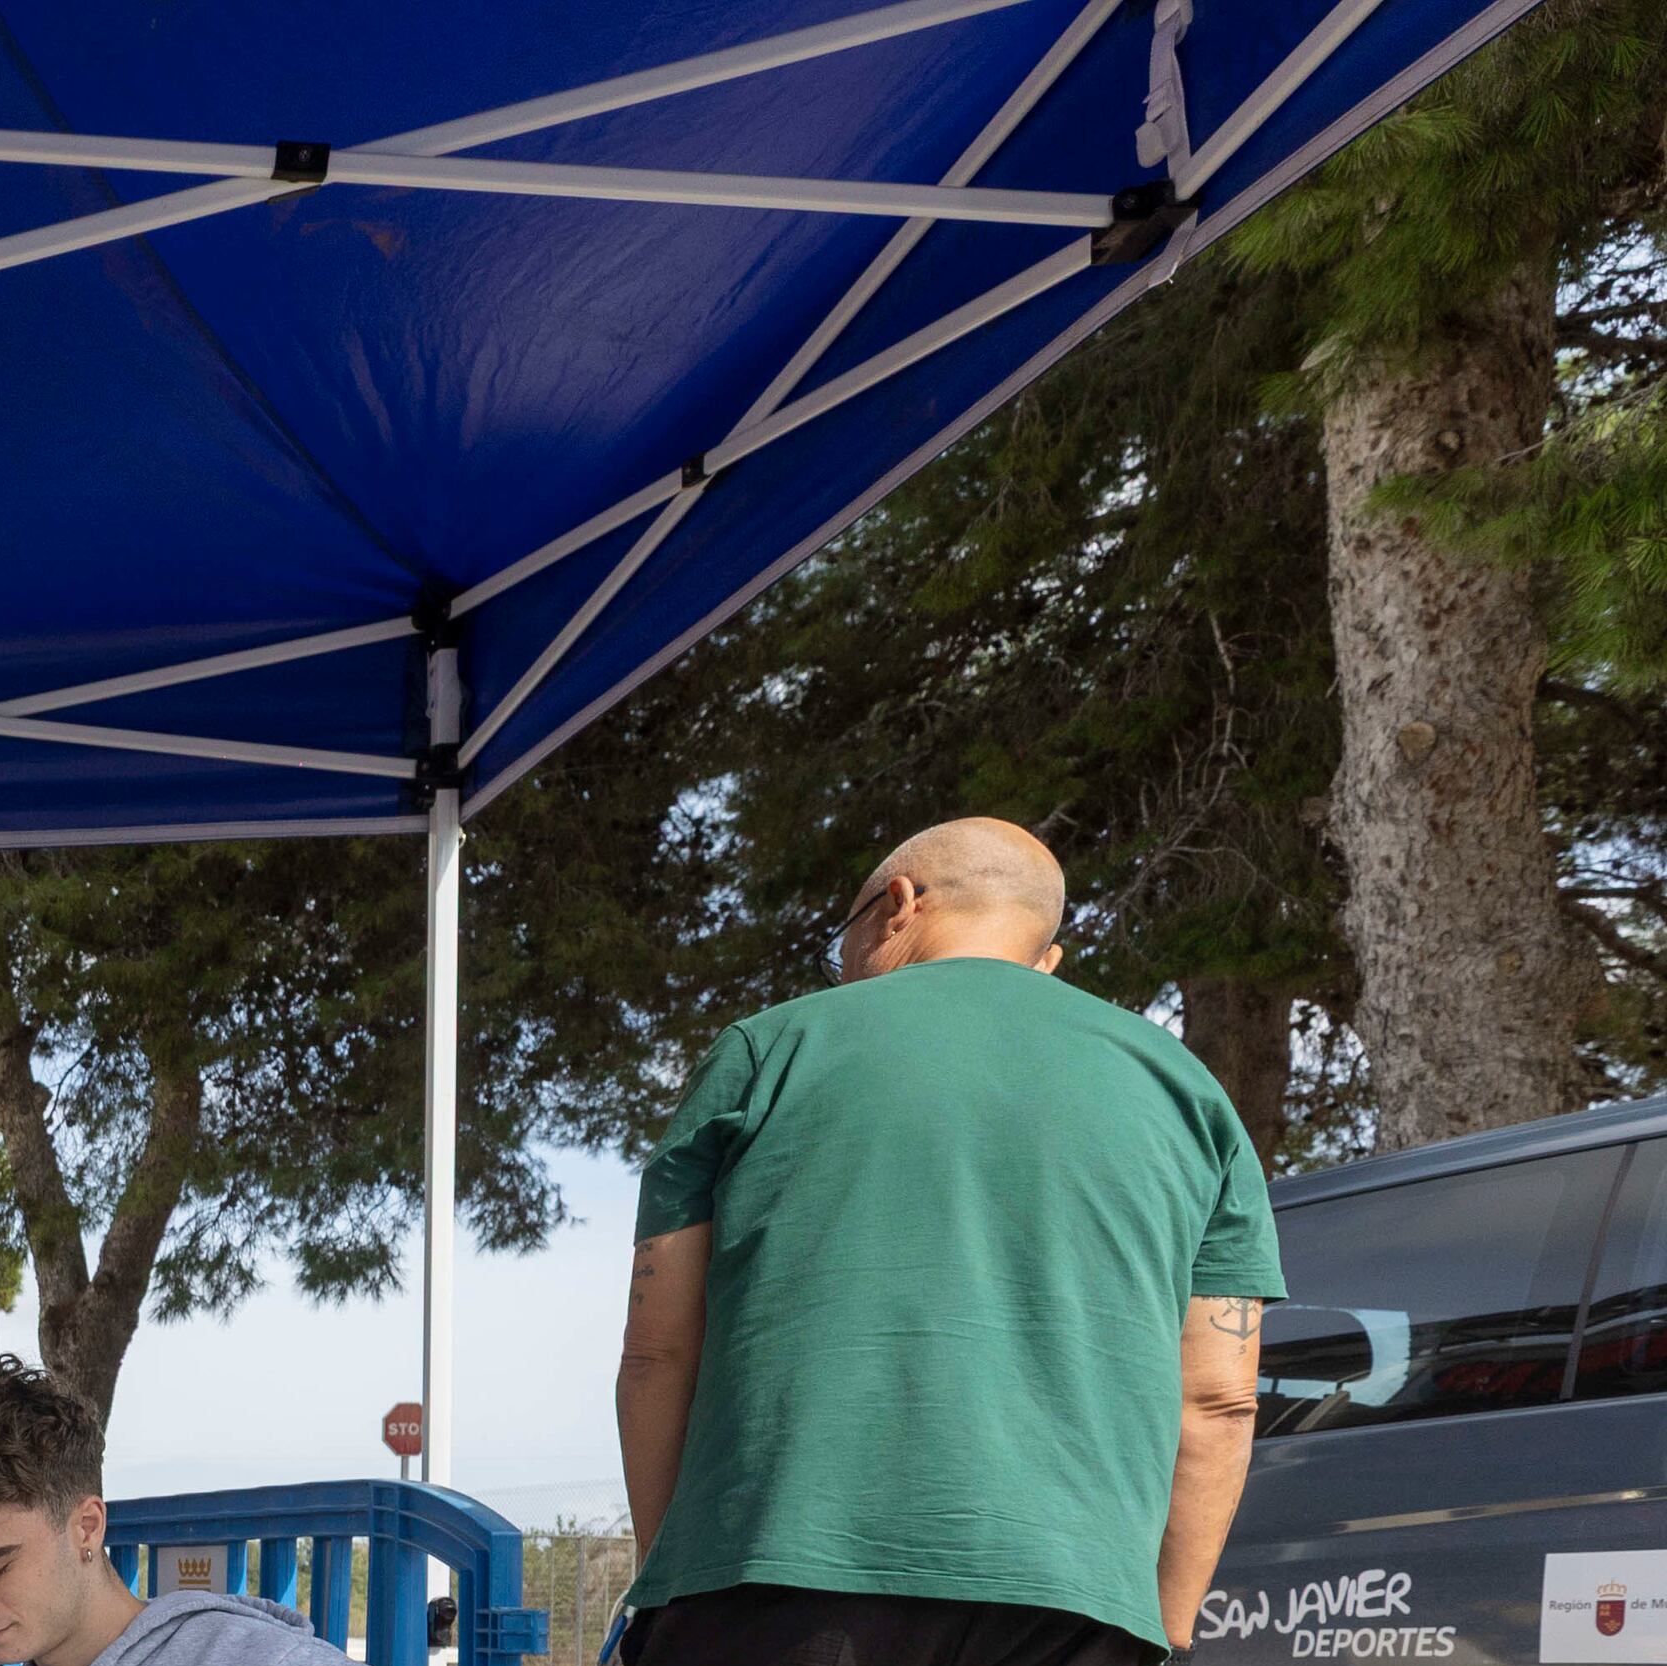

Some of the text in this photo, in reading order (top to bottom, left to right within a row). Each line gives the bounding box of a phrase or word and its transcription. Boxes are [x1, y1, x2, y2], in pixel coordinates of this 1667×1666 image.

[388, 1422, 423, 1436] STO
[1199, 1569, 1412, 1640] SAN JAVIER
[1630, 1598, 1647, 1610] de
[1292, 1626, 1457, 1658] DEPORTES
